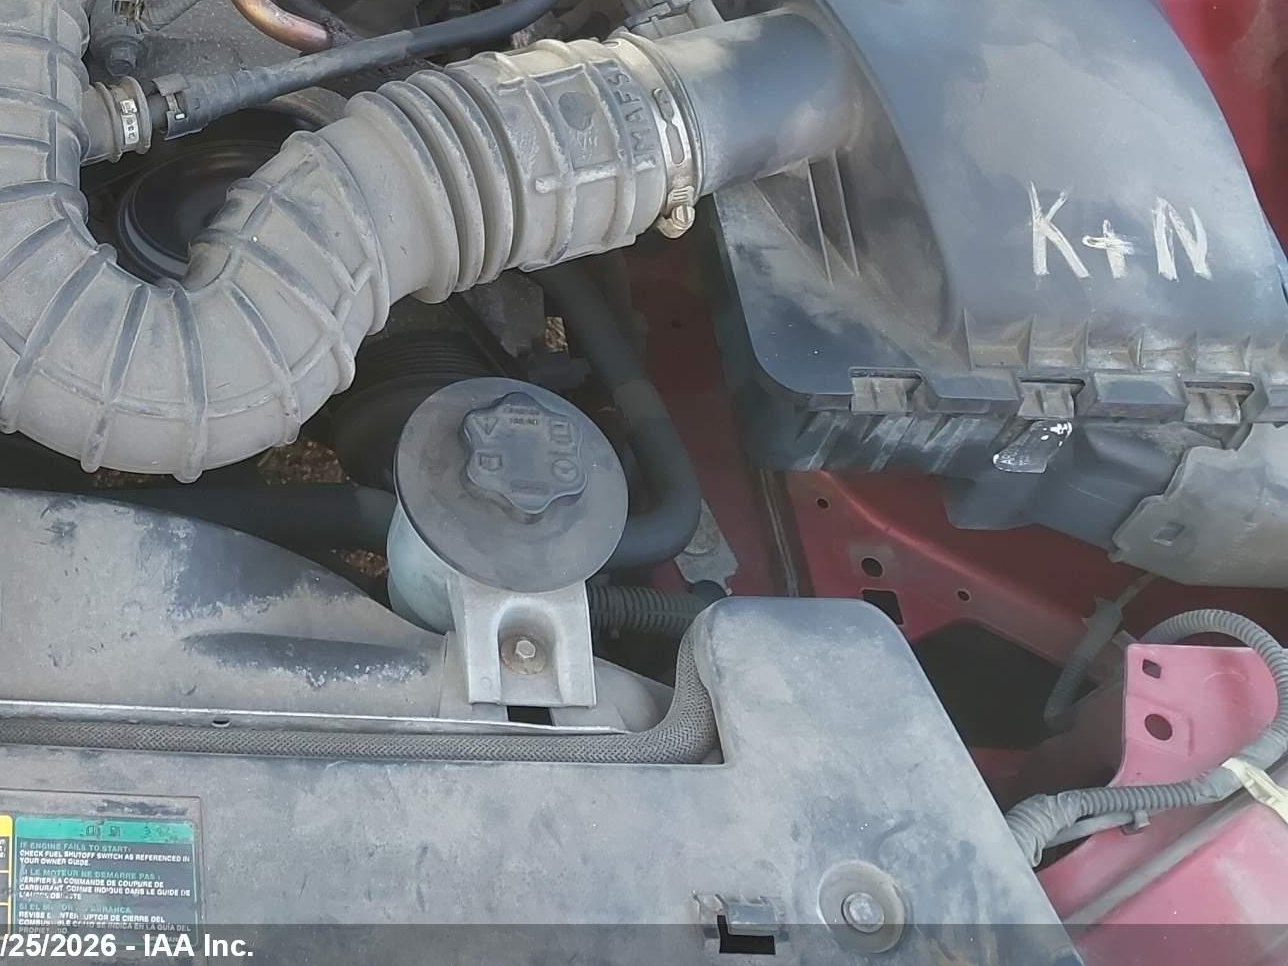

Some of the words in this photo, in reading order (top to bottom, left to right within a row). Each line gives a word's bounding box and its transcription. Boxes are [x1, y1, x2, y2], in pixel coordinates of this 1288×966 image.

[30, 842, 61, 851] ENGINE
[63, 842, 86, 851] FAILS
[45, 850, 63, 858] FUEL
[64, 851, 95, 859] SHUTOFF
[136, 854, 181, 862] REFERENCED
[63, 877, 105, 886] COMMANDE
[118, 880, 153, 888] COUPURE
[19, 884, 64, 892] CARBURANT
[125, 887, 145, 895] DANS
[18, 911, 45, 919] REVISE
